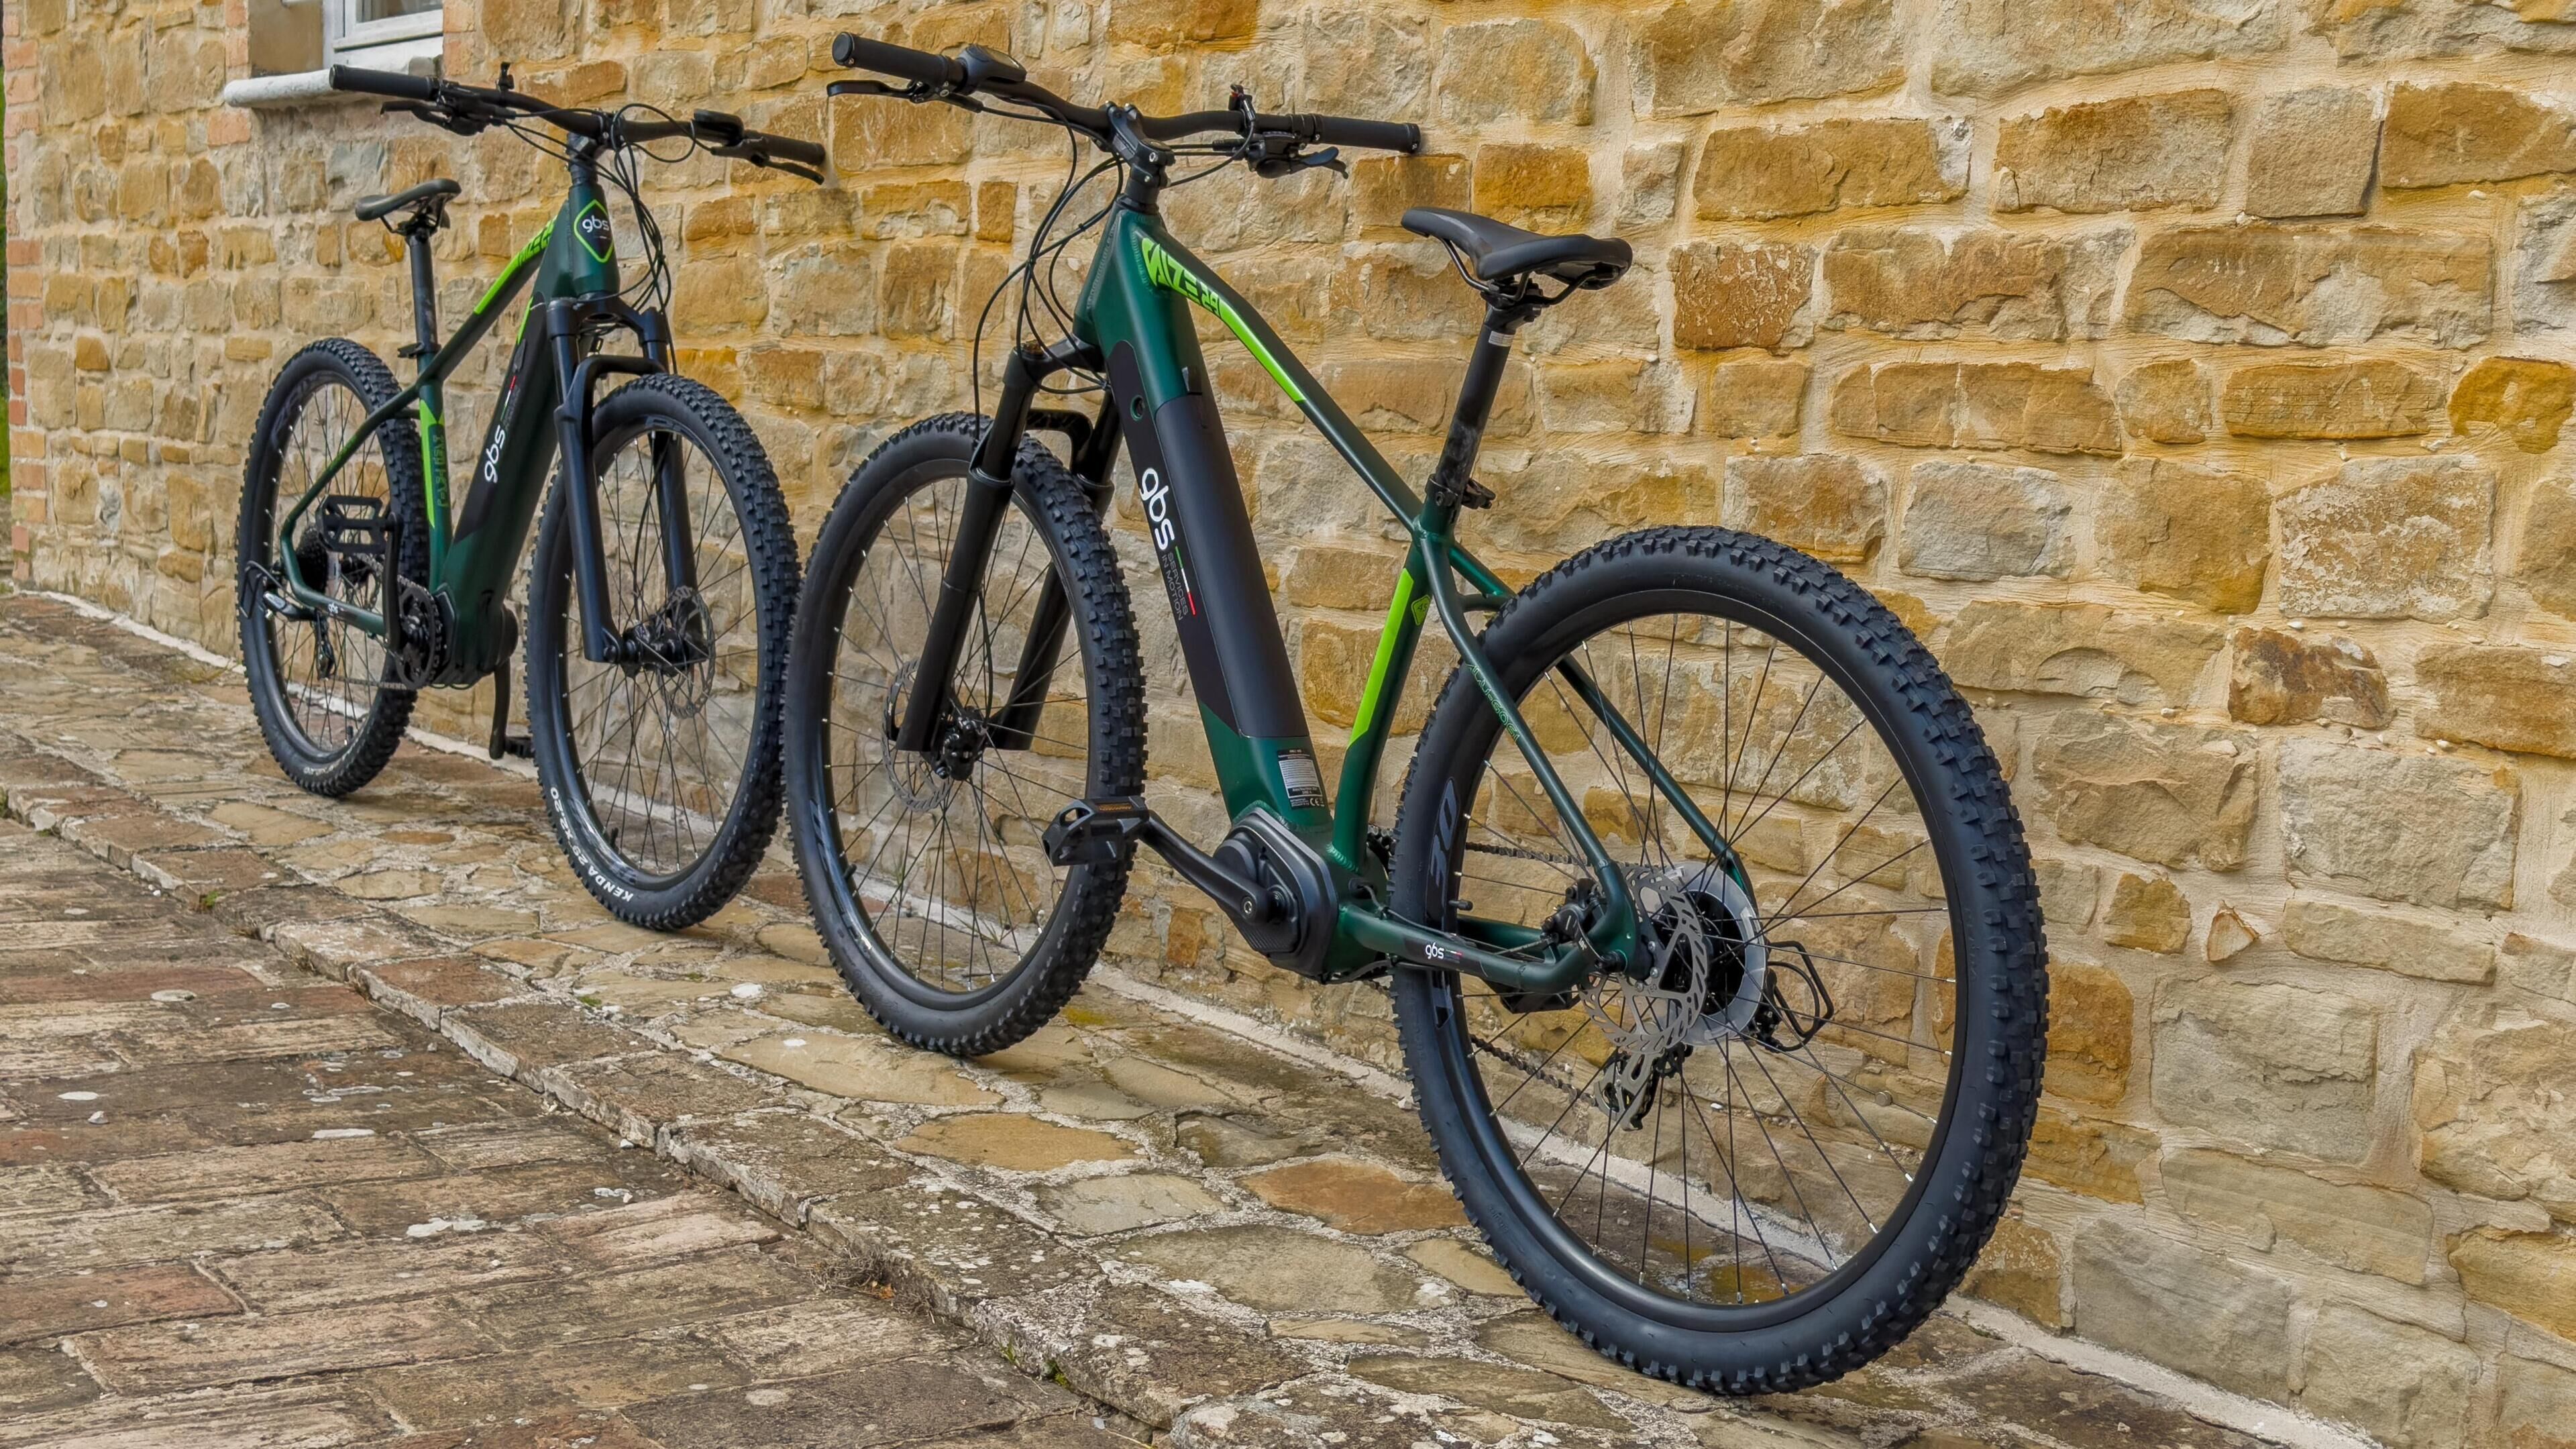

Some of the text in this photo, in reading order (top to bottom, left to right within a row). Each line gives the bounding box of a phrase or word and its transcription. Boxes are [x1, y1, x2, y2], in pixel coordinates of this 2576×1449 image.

[582, 215, 609, 233] gbs
[484, 425, 505, 483] gbs
[1139, 468, 1175, 550] gbs
[1162, 555, 1183, 621] IN MOTION
[1168, 551, 1189, 615] SERVICES
[588, 865, 634, 902] KENDA
[1426, 942, 1444, 959] gbs
